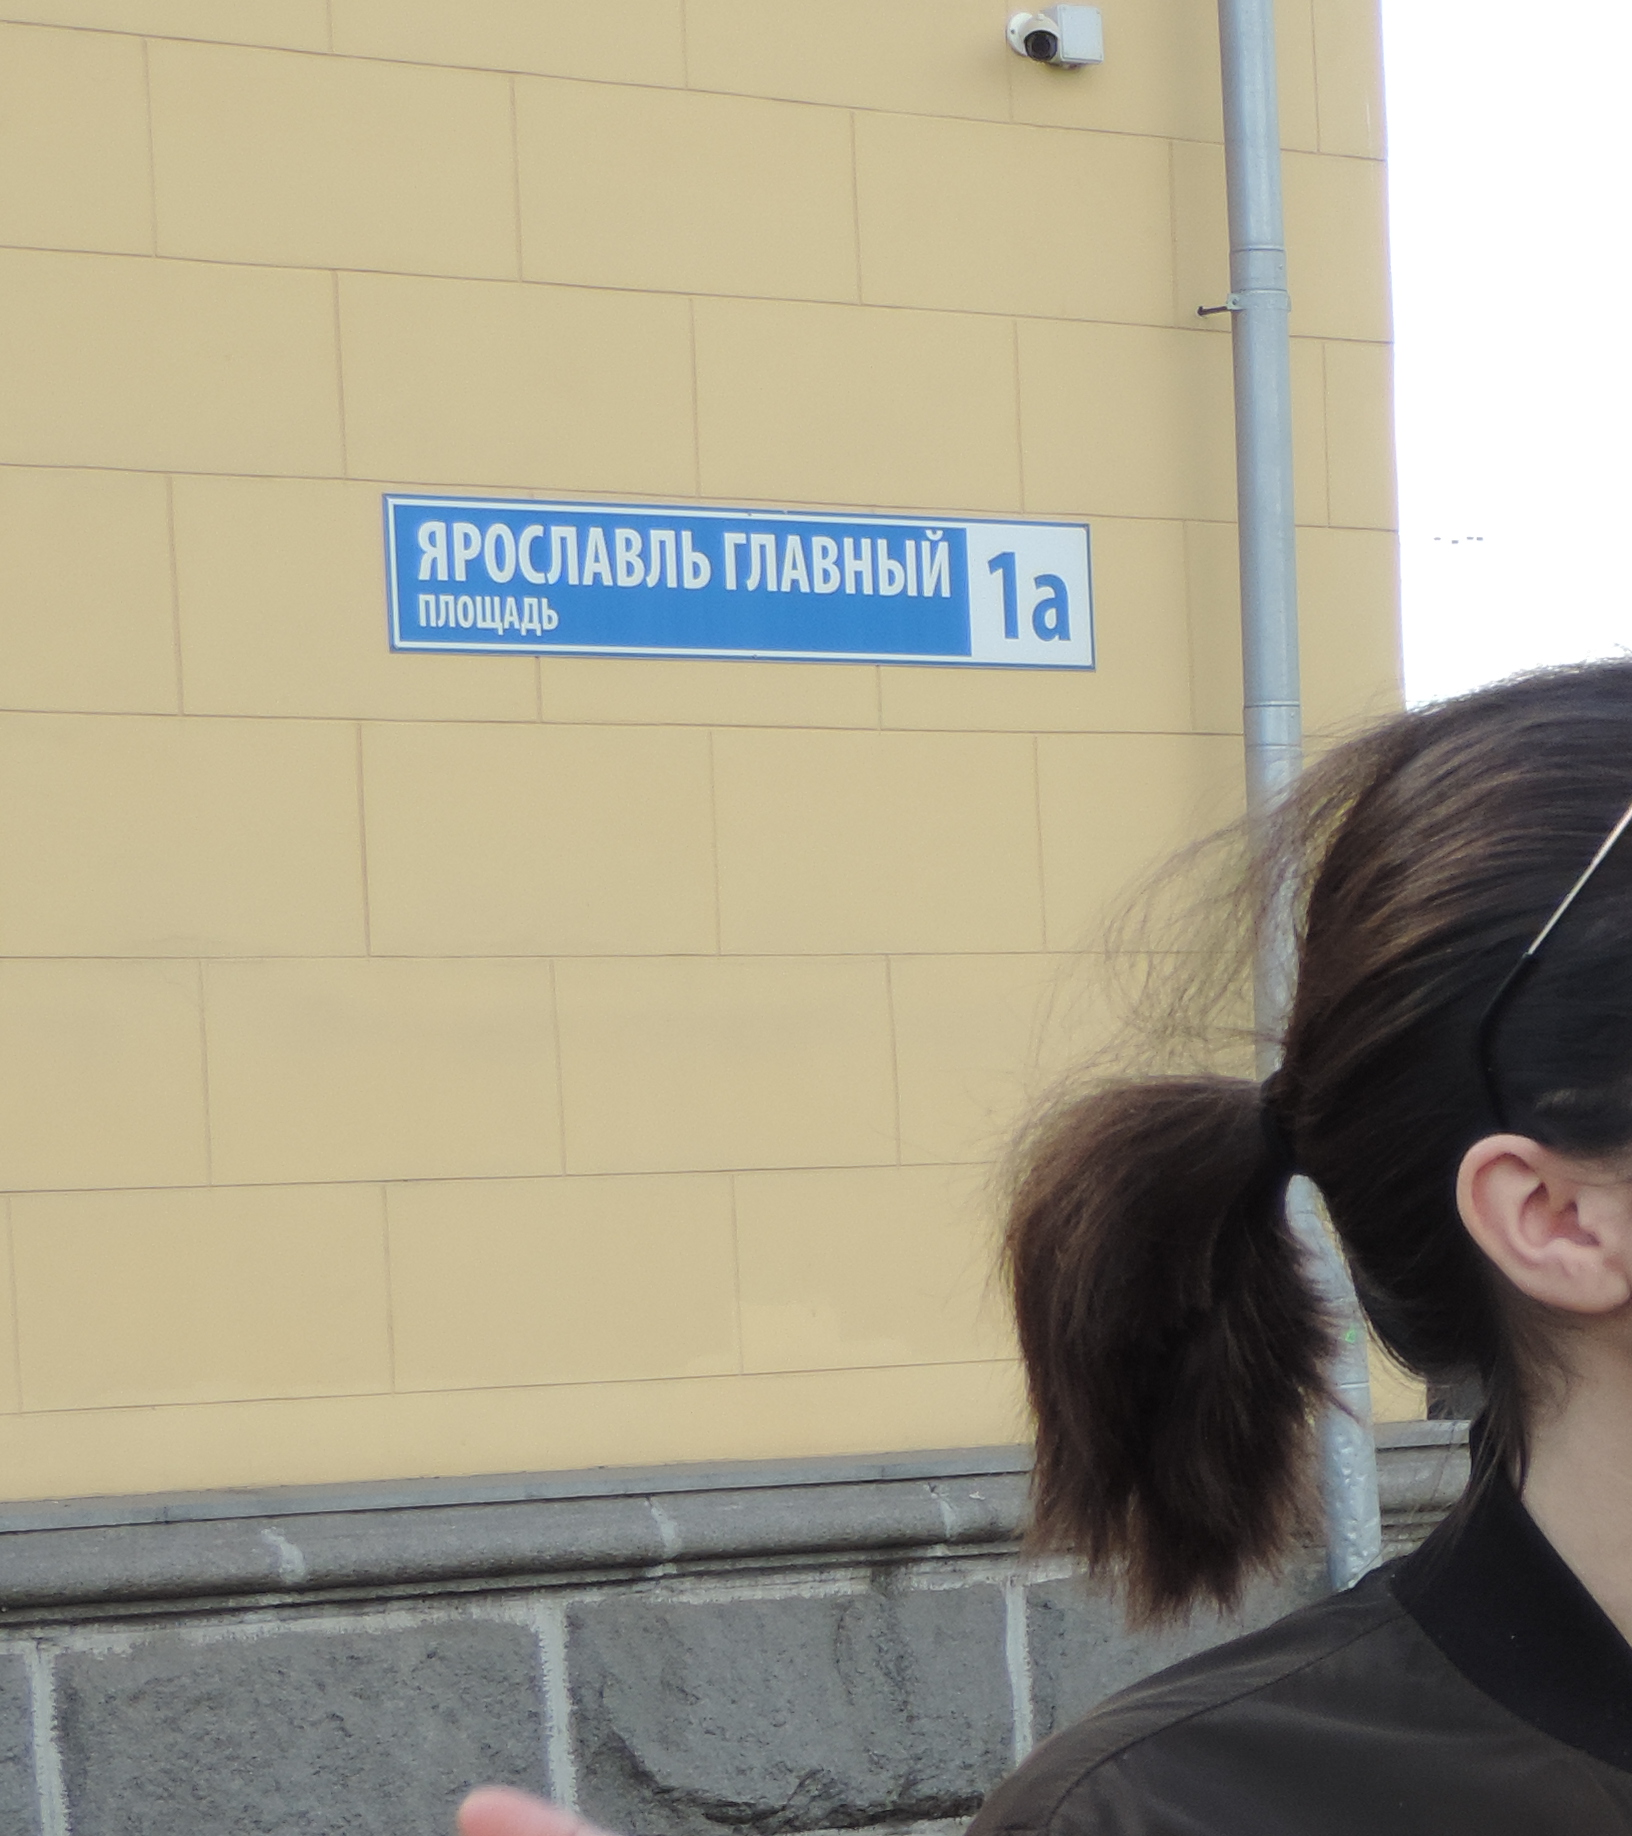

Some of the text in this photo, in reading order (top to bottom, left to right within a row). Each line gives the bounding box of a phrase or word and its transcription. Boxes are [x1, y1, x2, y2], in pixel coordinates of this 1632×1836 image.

[416, 519, 951, 598] ЯРОСЛАВЛЬ ГЛАВНЫЙ
[987, 551, 1071, 641] 1а
[417, 593, 559, 636] ПЛОЩАДЬ
